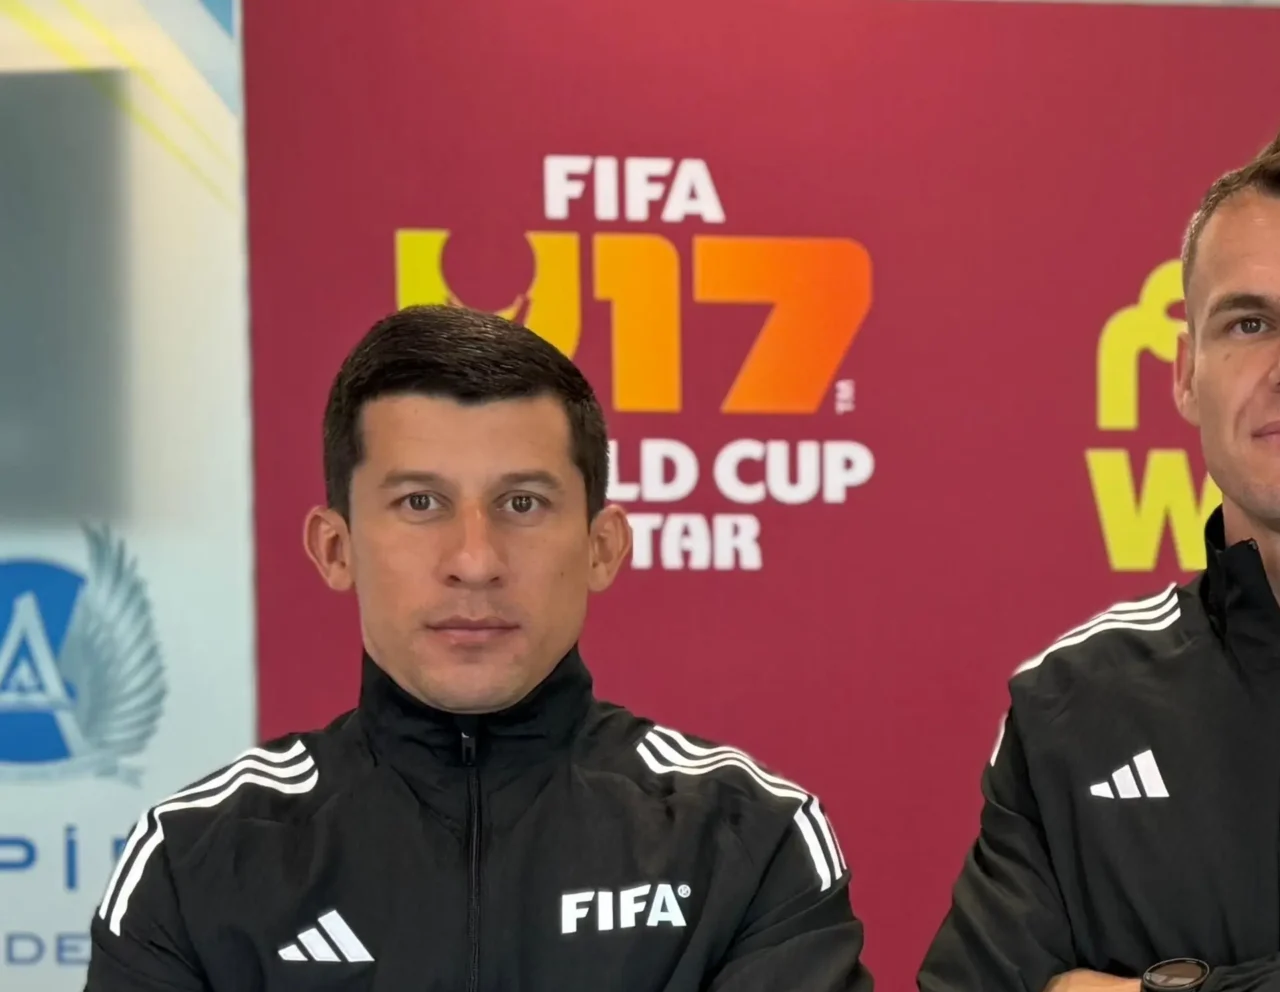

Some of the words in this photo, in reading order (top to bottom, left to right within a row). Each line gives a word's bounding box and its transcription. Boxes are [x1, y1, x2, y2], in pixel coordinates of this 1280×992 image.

[544, 155, 725, 222] FIFA
[713, 439, 875, 503] CUP
[626, 512, 762, 570] TAR
